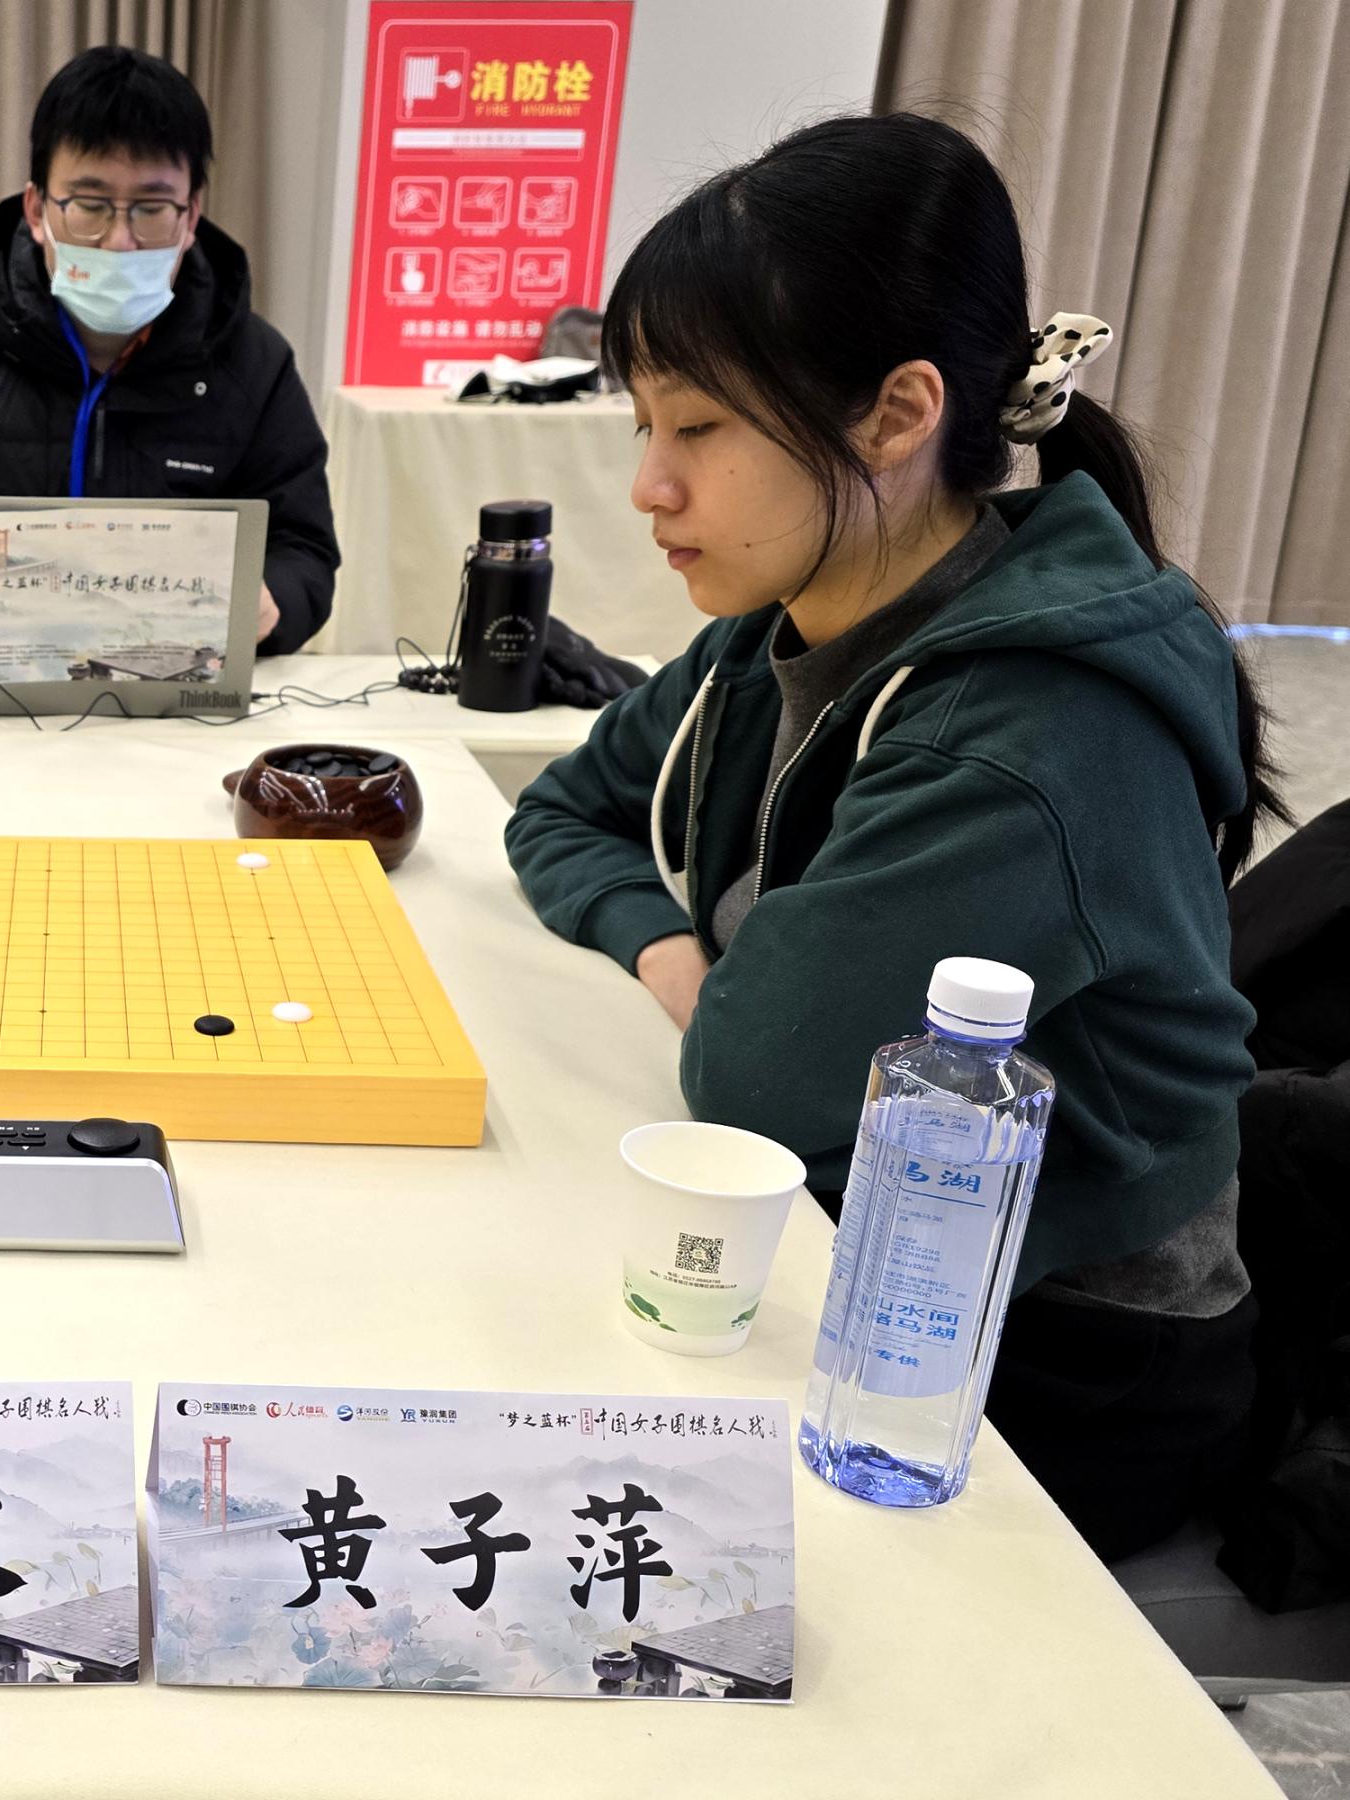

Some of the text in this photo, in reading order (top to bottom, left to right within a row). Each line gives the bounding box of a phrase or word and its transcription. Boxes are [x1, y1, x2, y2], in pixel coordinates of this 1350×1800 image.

[470, 60, 594, 102] 消防栓
[179, 689, 242, 709] ThinkBook
[203, 1402, 257, 1412] 中国围棋协会
[278, 1476, 672, 1622] 黄子萍
